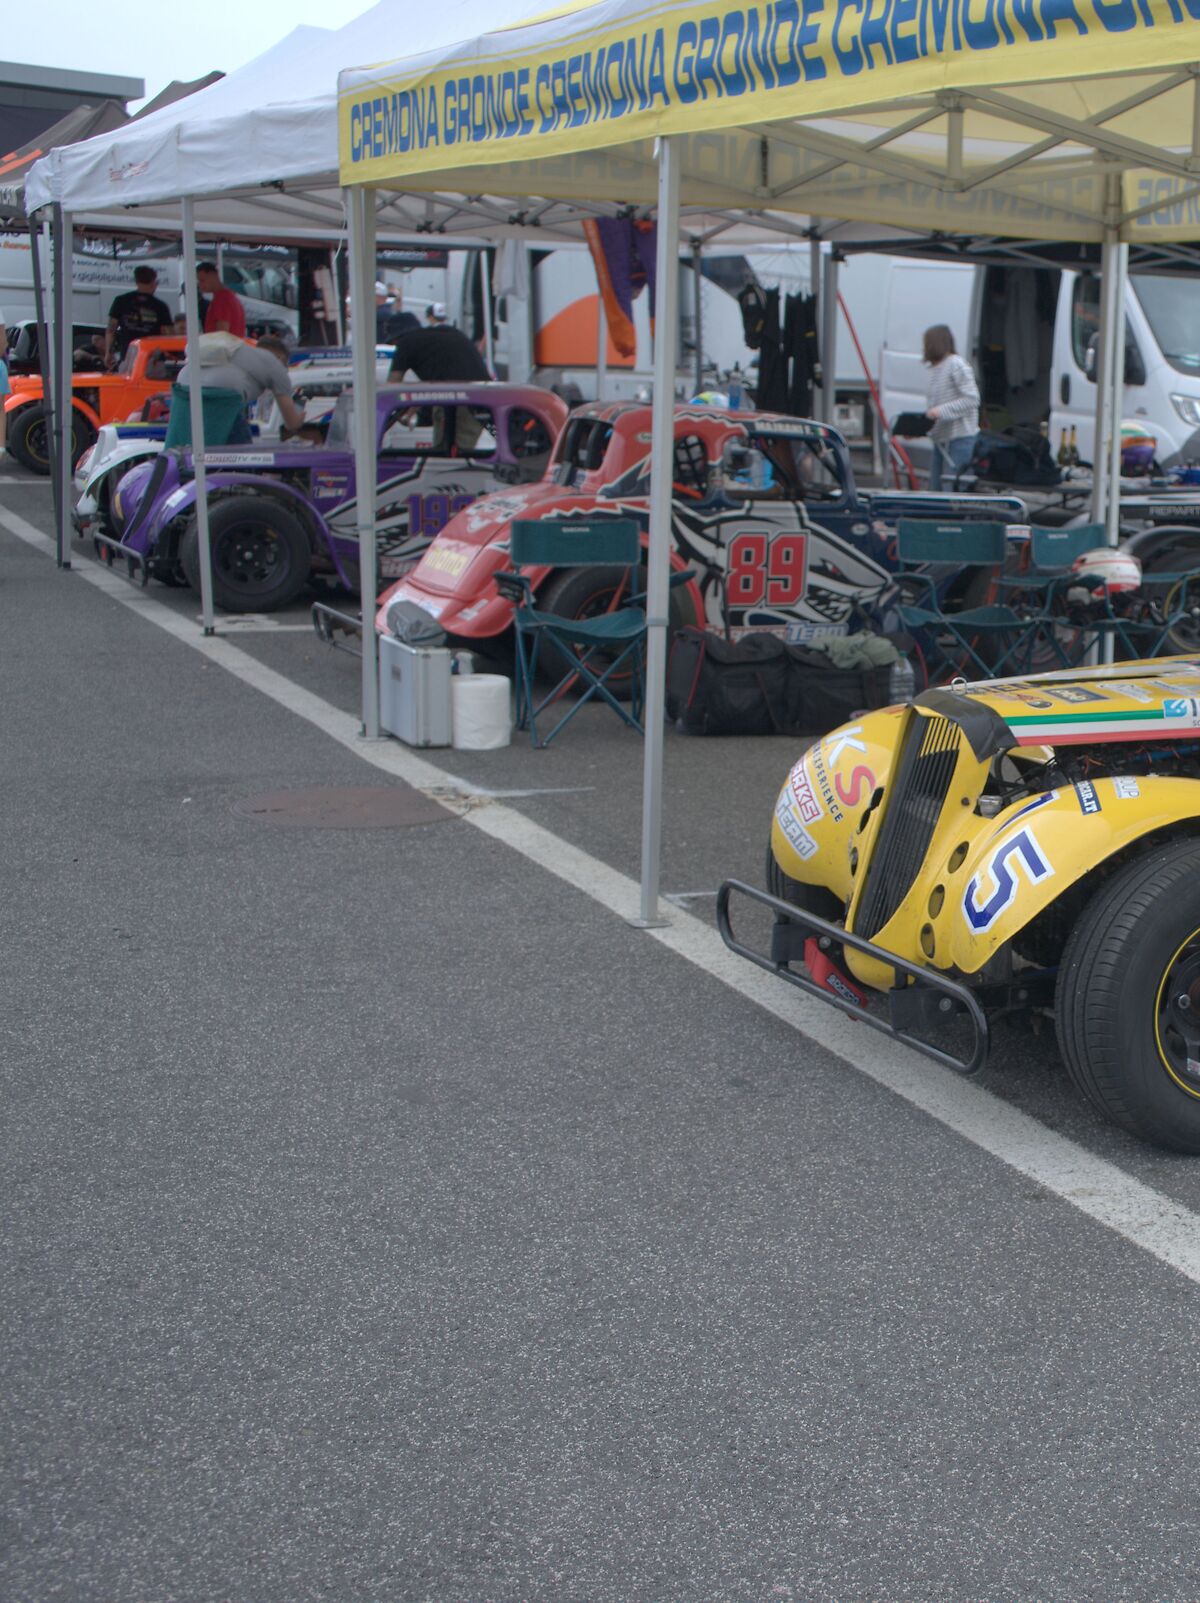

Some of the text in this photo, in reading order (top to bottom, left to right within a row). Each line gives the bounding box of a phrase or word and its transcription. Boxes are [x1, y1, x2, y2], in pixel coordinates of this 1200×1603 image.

[350, 85, 440, 164] CREMONA
[444, 66, 531, 146] GRONDE
[536, 26, 667, 135] CREMONA
[673, 0, 828, 104] GRONDE
[727, 532, 807, 606] 89
